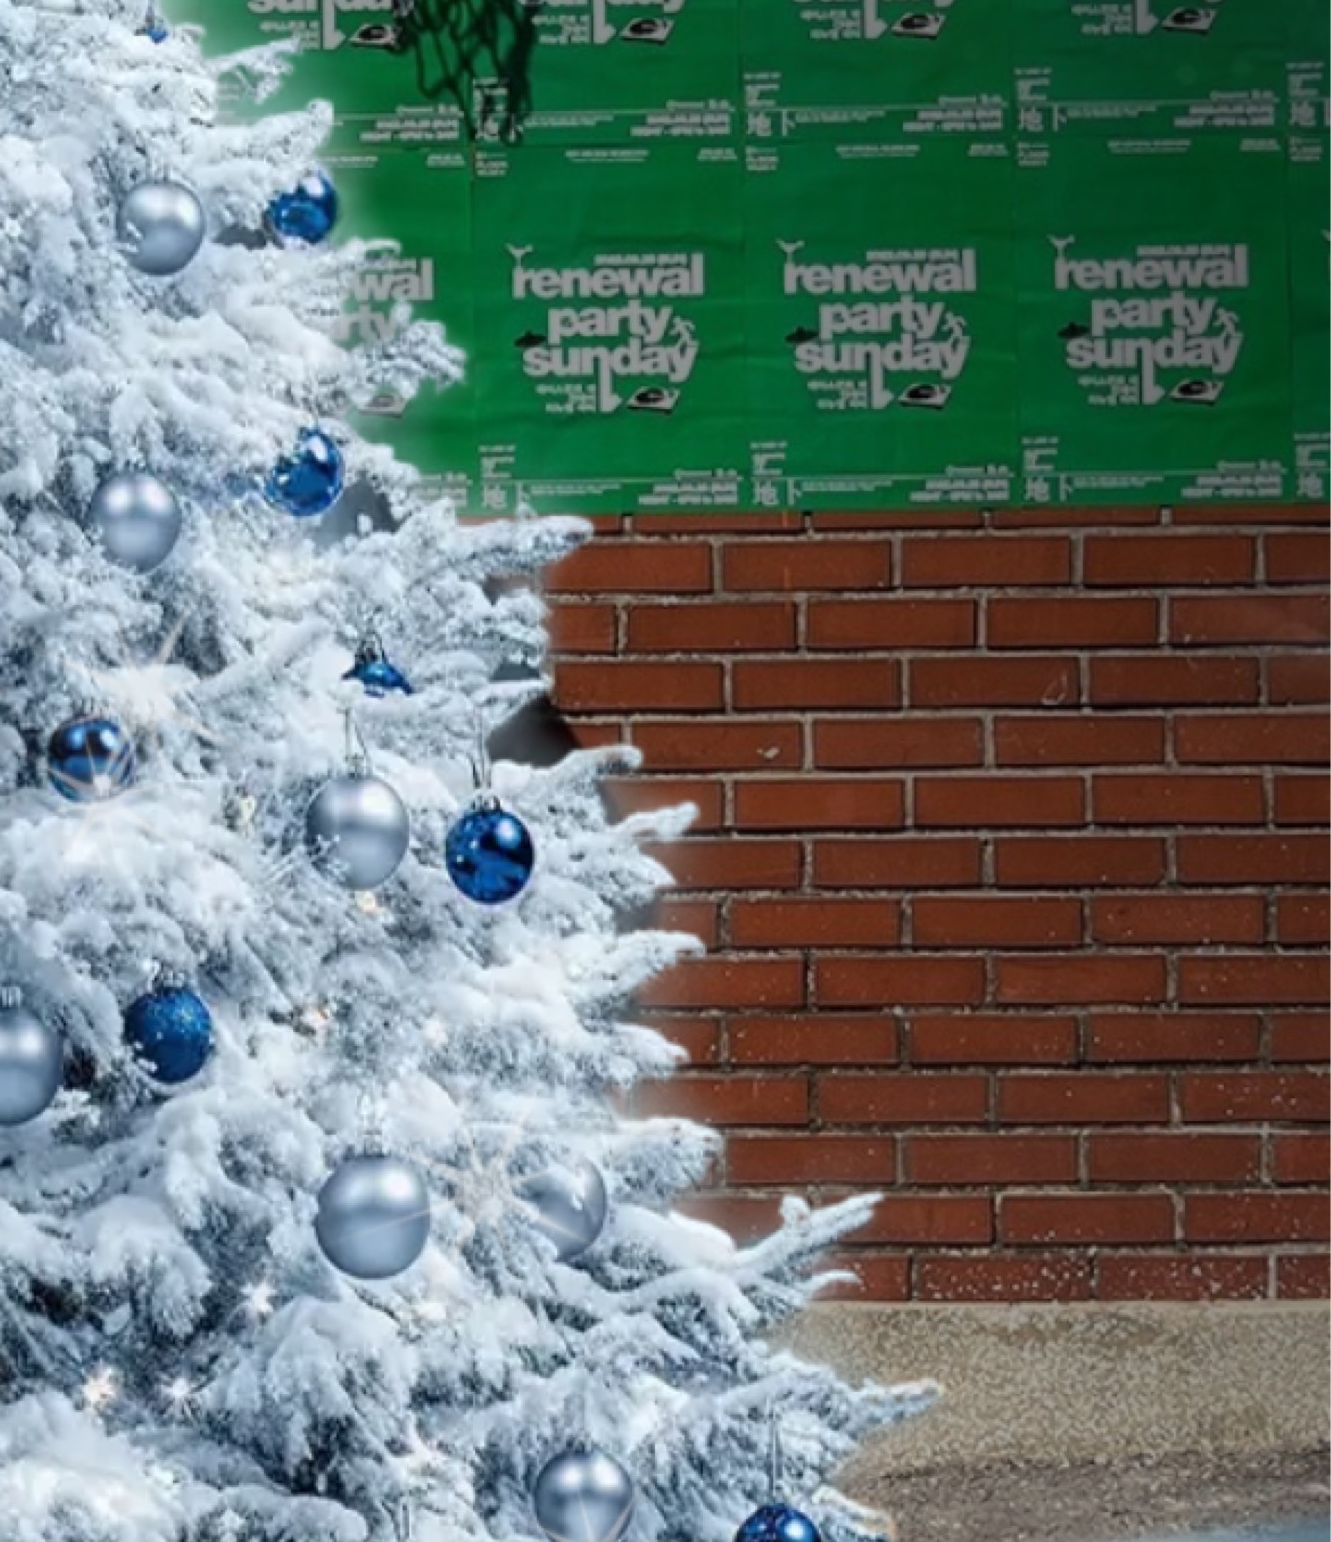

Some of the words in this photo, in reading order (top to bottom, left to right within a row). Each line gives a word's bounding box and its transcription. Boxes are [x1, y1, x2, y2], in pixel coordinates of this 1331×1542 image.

[513, 254, 703, 297] renewal
[785, 249, 975, 293] renewal
[1056, 245, 1247, 288] renewal
[548, 300, 672, 343] party
[819, 295, 944, 339] party
[1090, 291, 1216, 335] party
[523, 336, 699, 413] sunday
[794, 332, 971, 409] sunday
[1065, 328, 1243, 405] sunday
